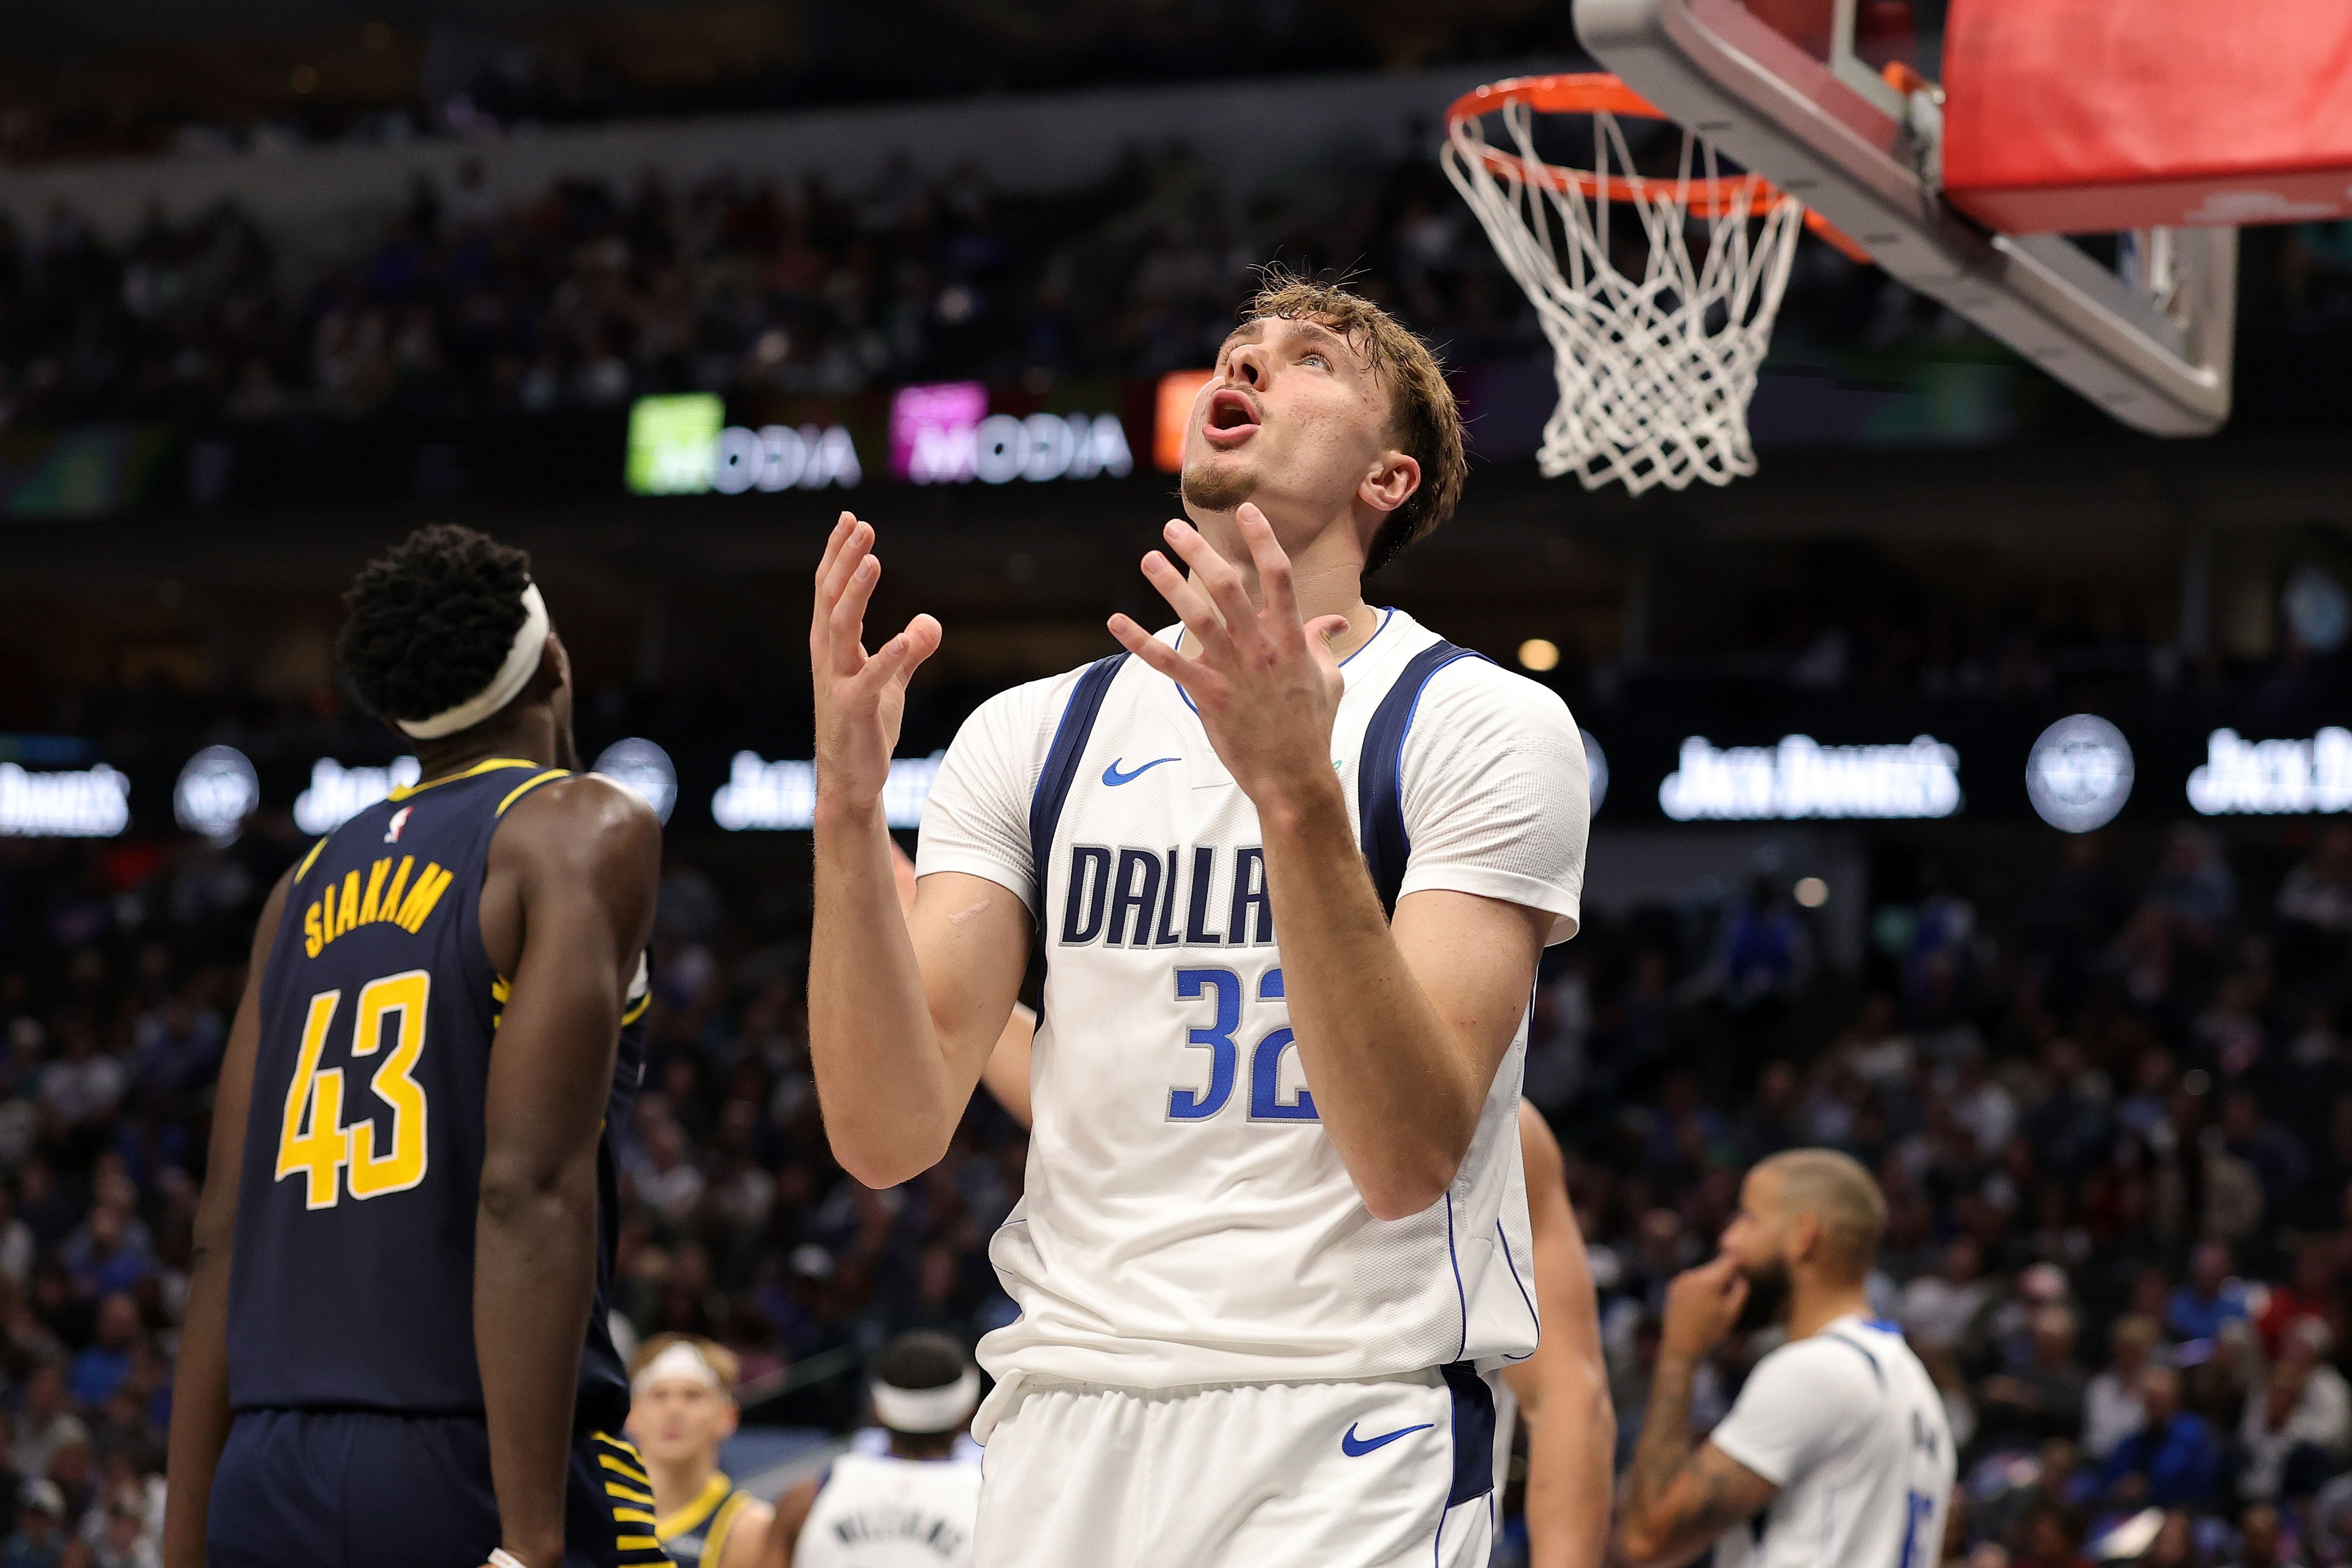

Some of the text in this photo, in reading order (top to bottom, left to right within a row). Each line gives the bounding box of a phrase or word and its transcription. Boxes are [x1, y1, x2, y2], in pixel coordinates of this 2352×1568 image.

[304, 854, 455, 959] SIAKAM
[1058, 843, 1278, 949] DALLA
[274, 968, 431, 1211] 43
